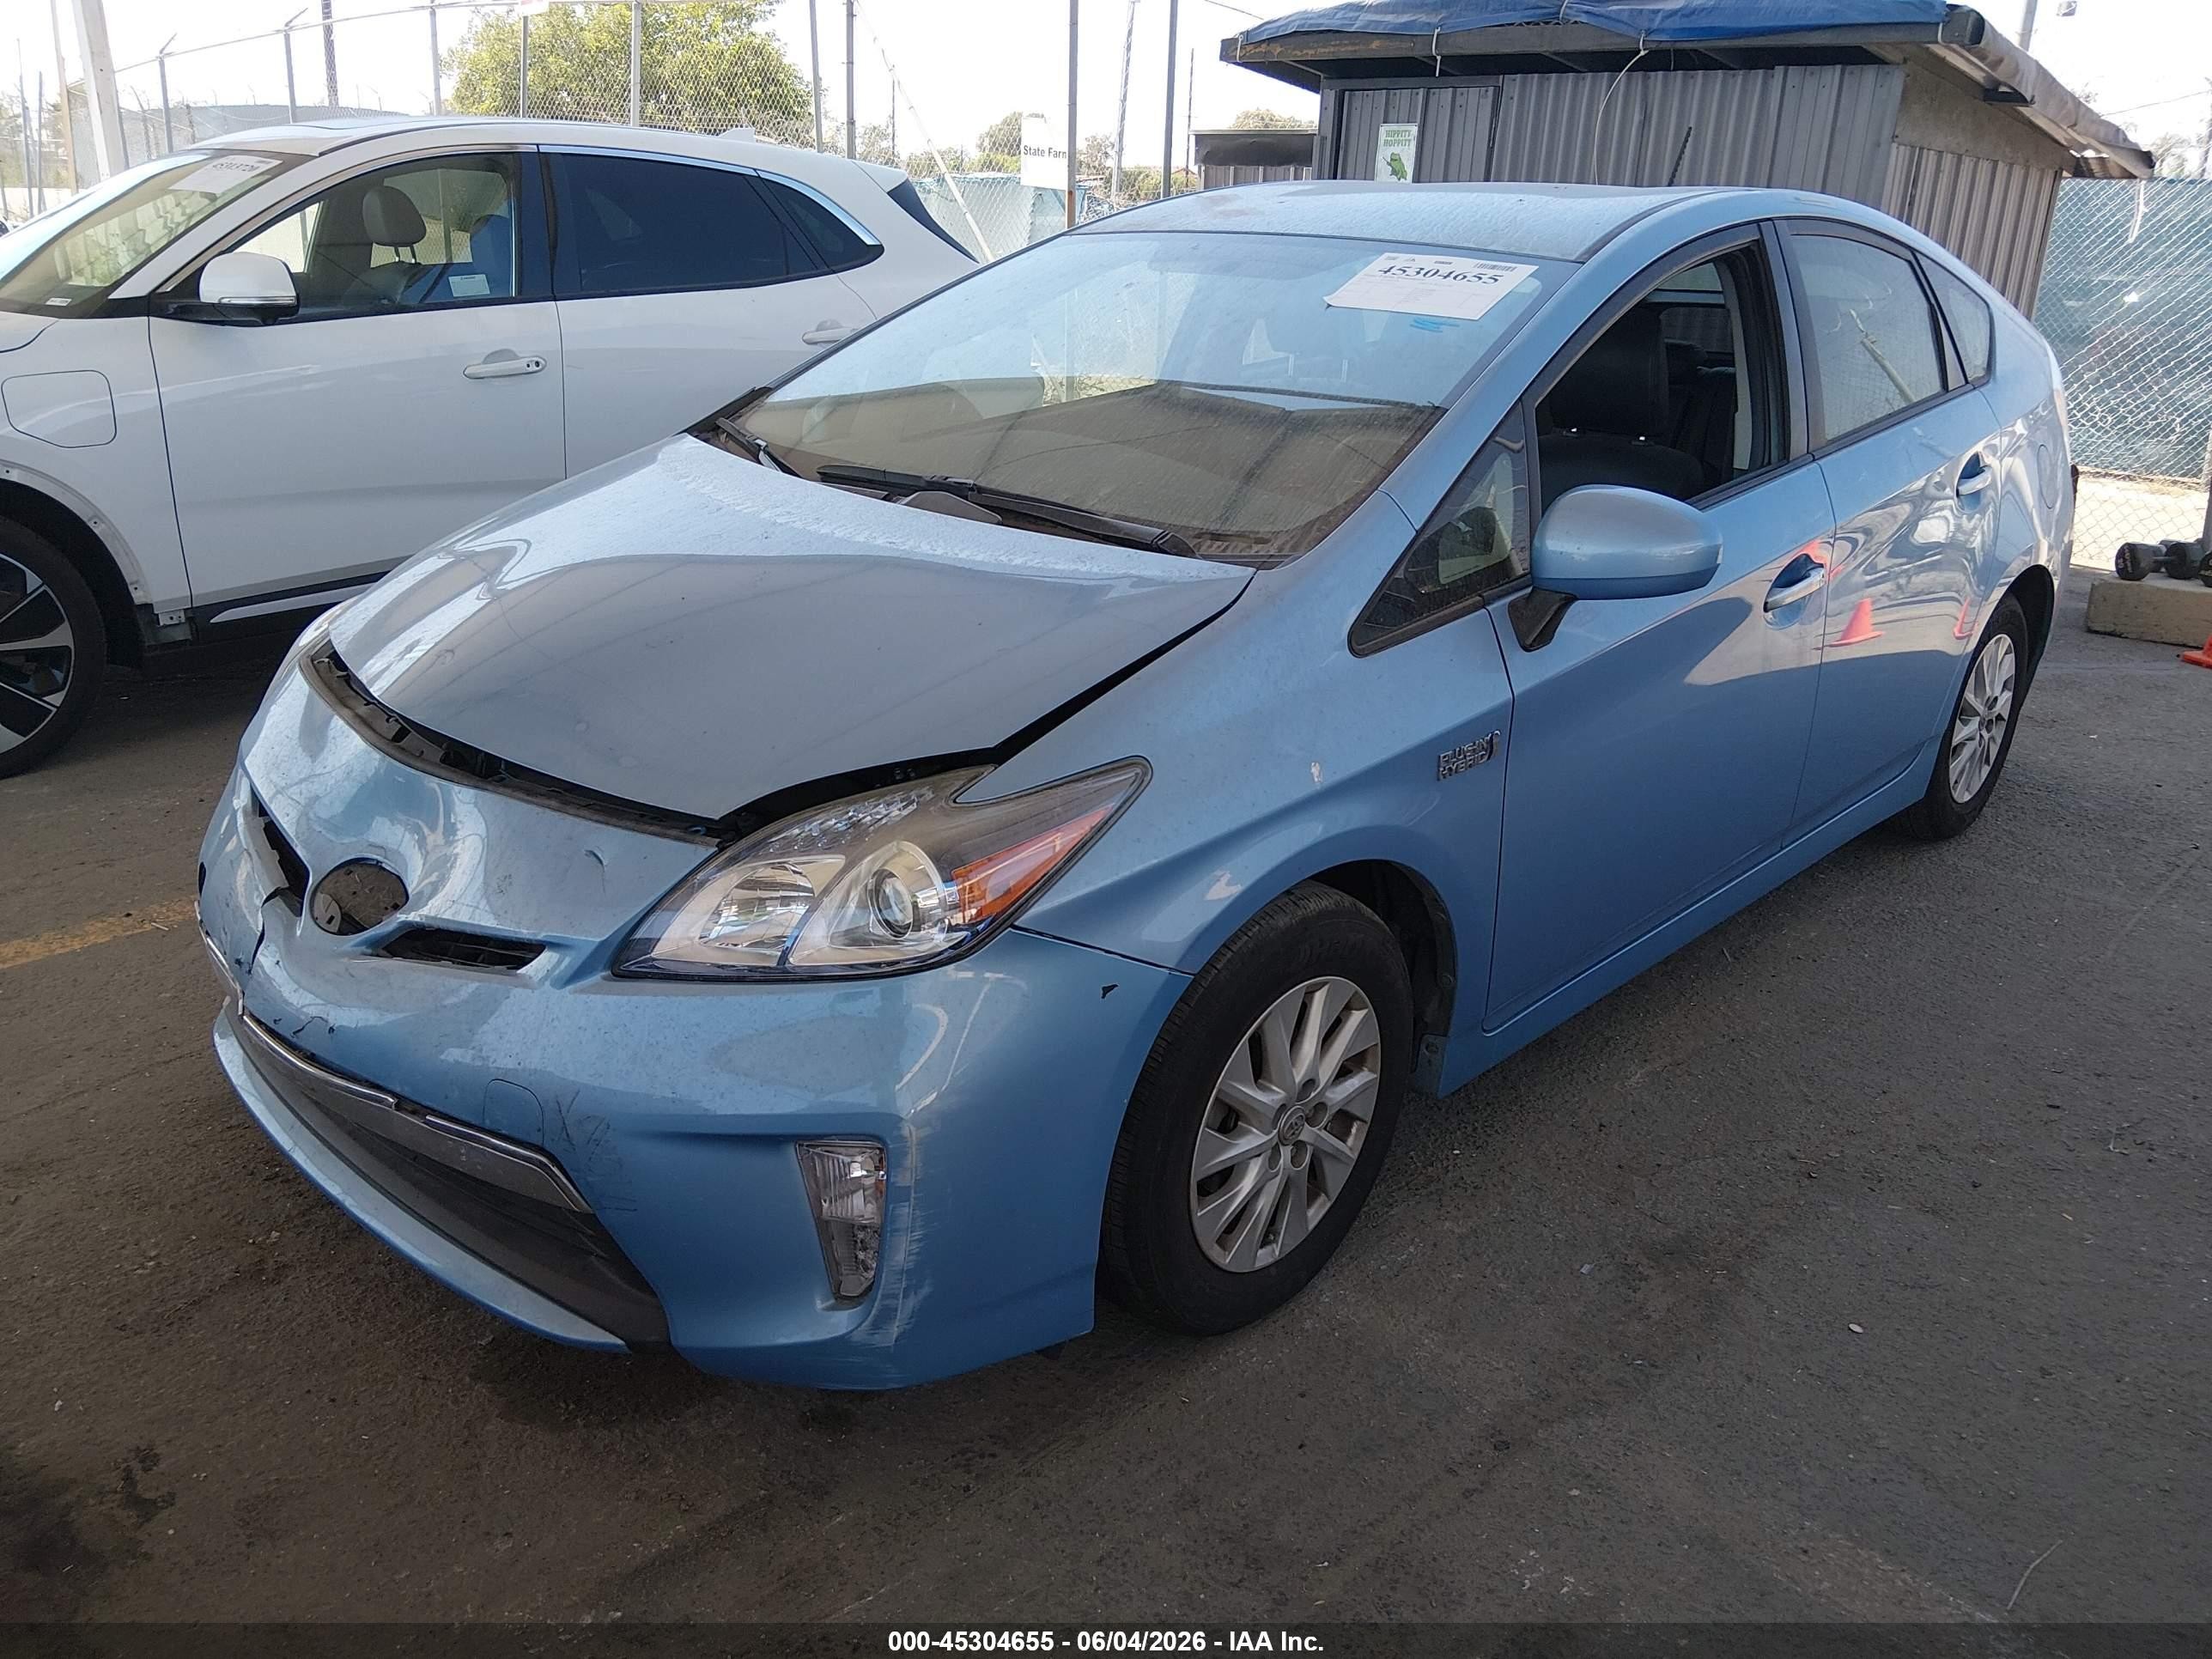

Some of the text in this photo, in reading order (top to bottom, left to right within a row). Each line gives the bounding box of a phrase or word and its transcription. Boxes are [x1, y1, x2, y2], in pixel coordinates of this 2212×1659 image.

[1385, 130, 1412, 138] HIPPITY
[1023, 144, 1045, 157] State
[1378, 264, 1504, 284] 45304655
